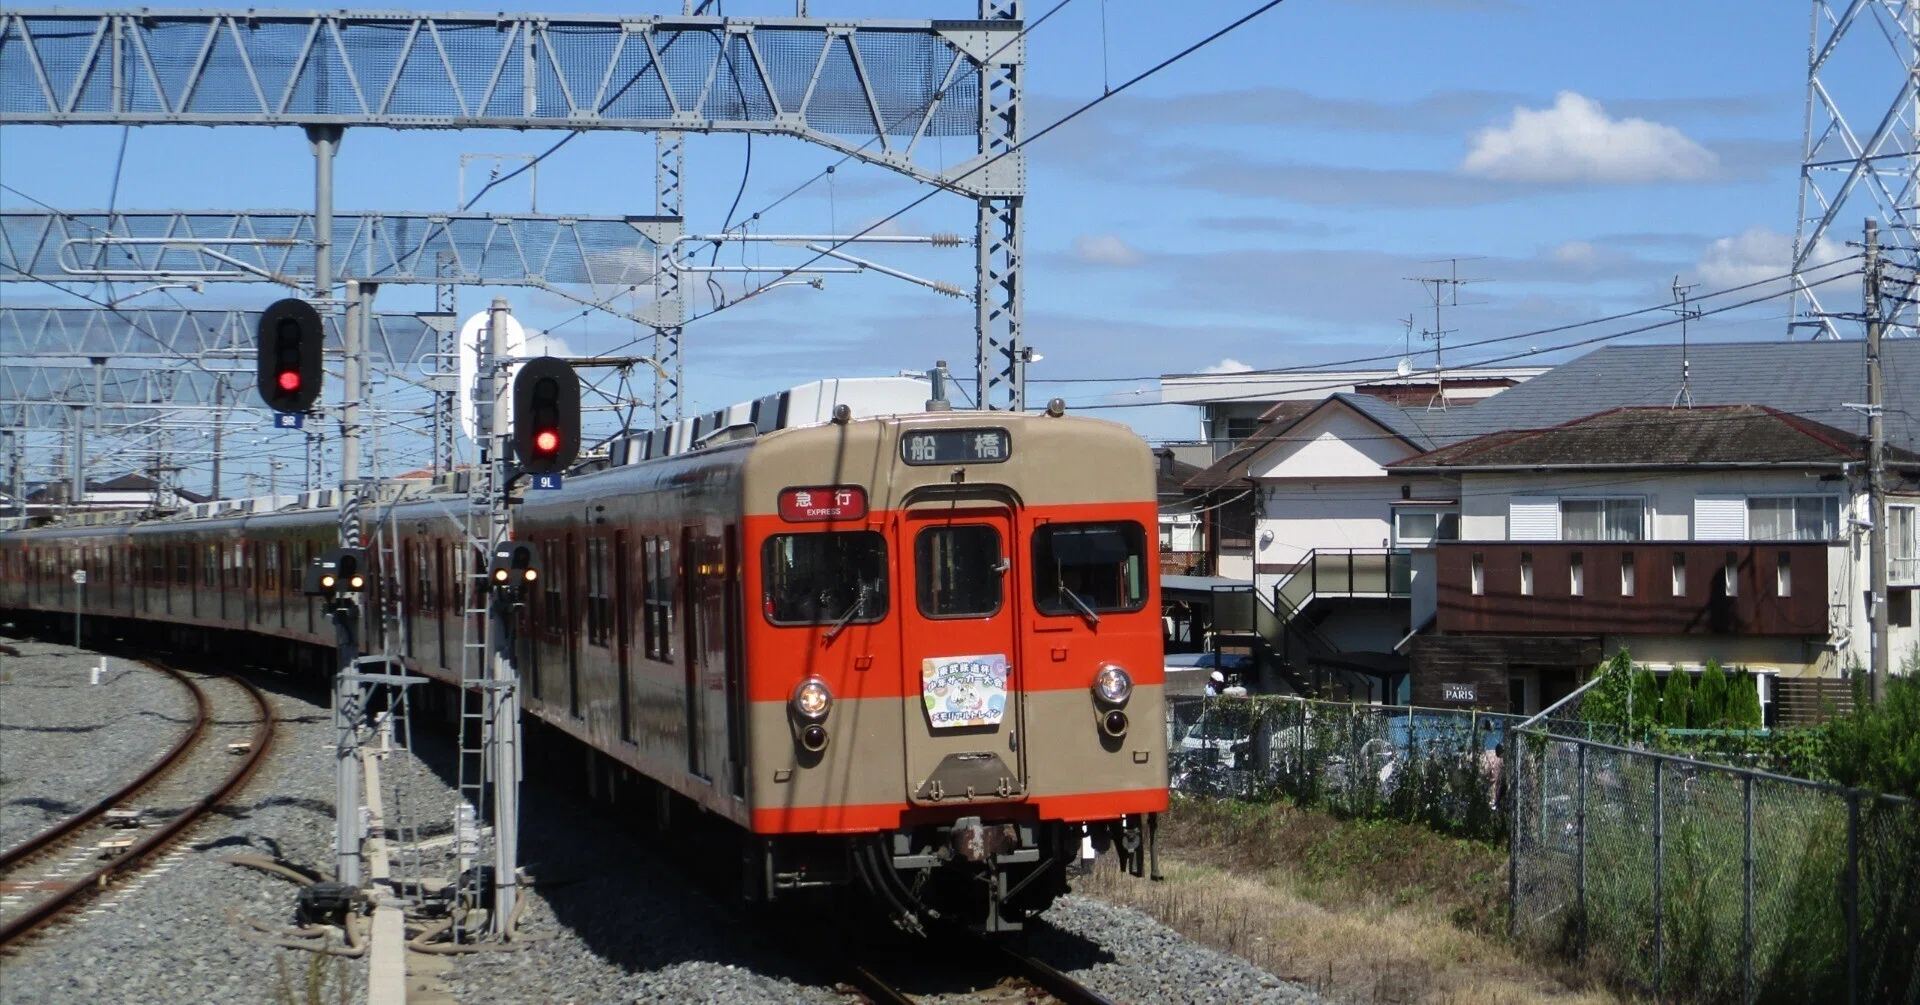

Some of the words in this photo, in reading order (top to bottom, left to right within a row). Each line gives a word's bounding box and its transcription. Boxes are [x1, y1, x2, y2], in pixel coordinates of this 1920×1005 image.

[911, 434, 999, 460] 船橋
[540, 476, 554, 488] 9L
[795, 489, 851, 508] 急行
[806, 507, 841, 516] EXPRESS
[927, 674, 1003, 692] 少年サッカー大会
[1445, 690, 1474, 700] PARIS
[932, 708, 1000, 721] メモリアルトレイン
